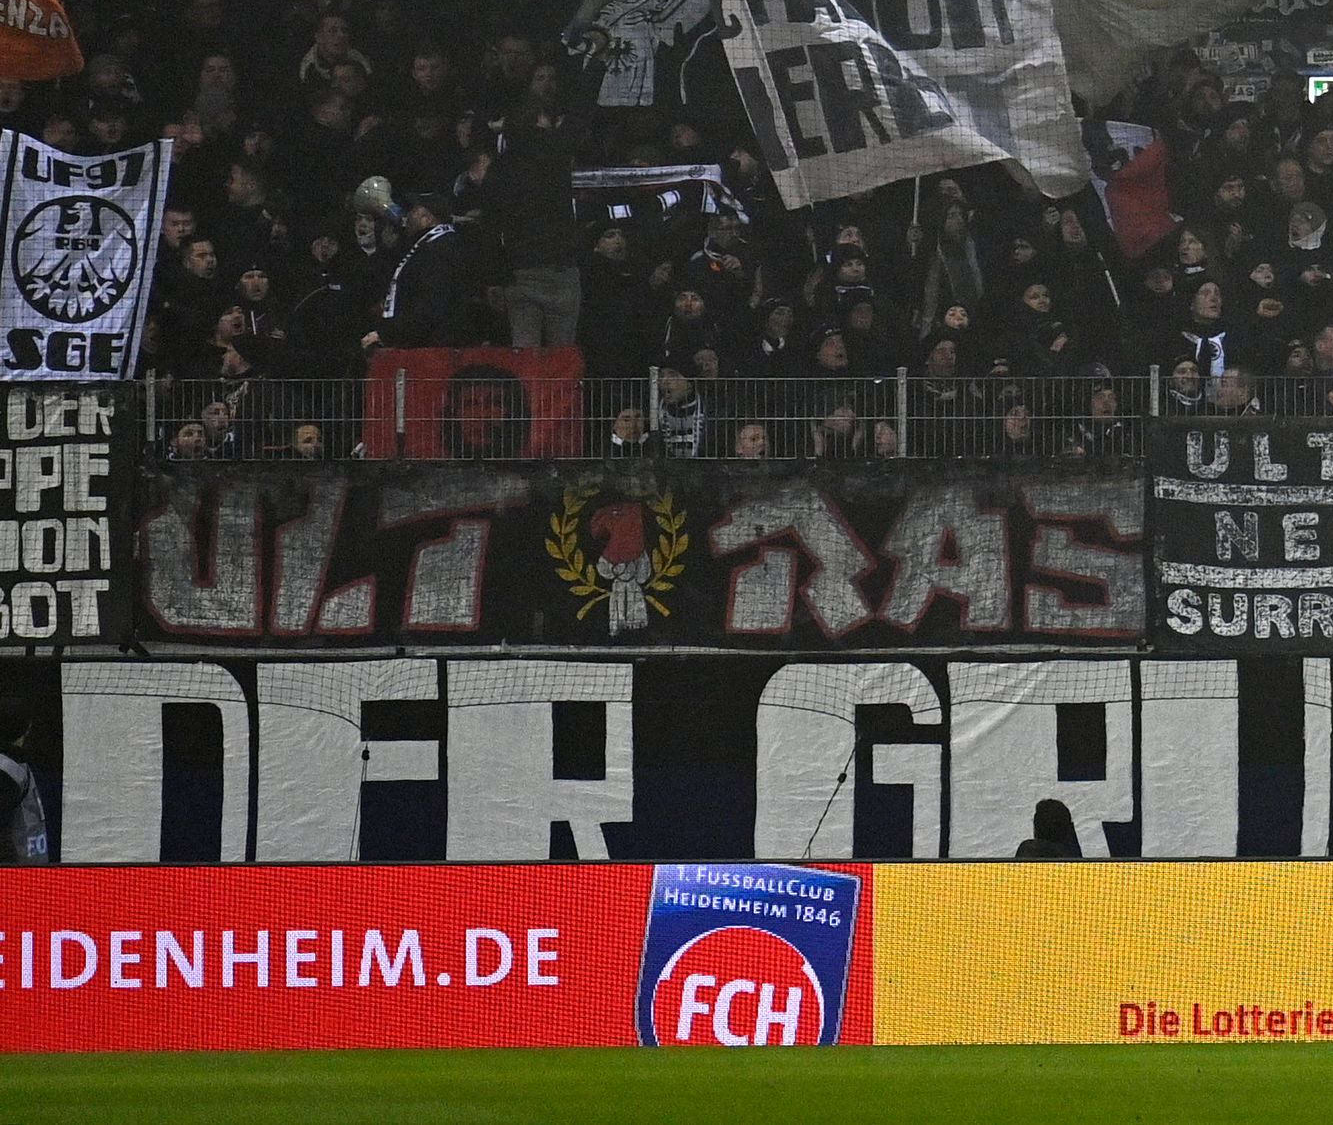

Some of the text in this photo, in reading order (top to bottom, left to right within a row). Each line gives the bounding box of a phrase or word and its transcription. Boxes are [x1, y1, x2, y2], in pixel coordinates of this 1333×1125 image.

[21, 146, 146, 189] UF97
[3, 328, 126, 373] SGE
[7, 393, 114, 441] DER
[794, 905, 840, 927] 1846
[0, 928, 561, 989] EIDENHEIM.DE
[676, 975, 802, 1045] FCH
[1119, 1007, 1181, 1037] Die
